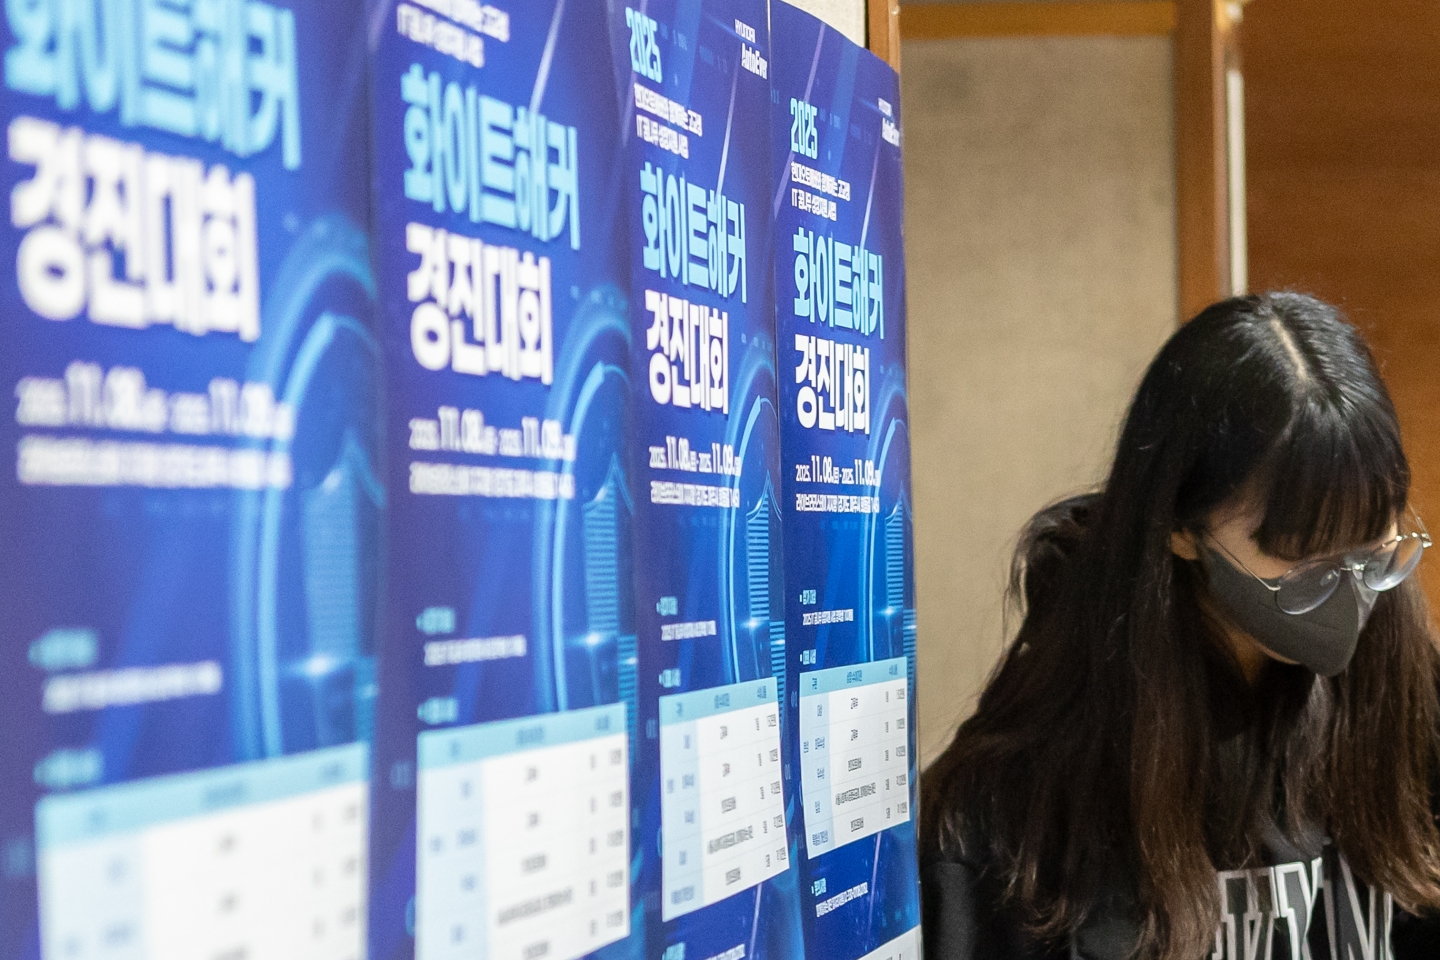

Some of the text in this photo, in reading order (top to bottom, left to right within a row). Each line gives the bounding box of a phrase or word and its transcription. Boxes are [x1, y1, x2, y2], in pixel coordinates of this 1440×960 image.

[625, 7, 662, 83] 2025
[401, 62, 581, 250] 화이트해커
[790, 98, 818, 160] 2025
[639, 161, 747, 304] 화이트해커
[793, 226, 885, 340] 화이트해커
[405, 222, 553, 385] 경진대회
[645, 289, 729, 415] 경진대회
[794, 333, 871, 435] 경진대회
